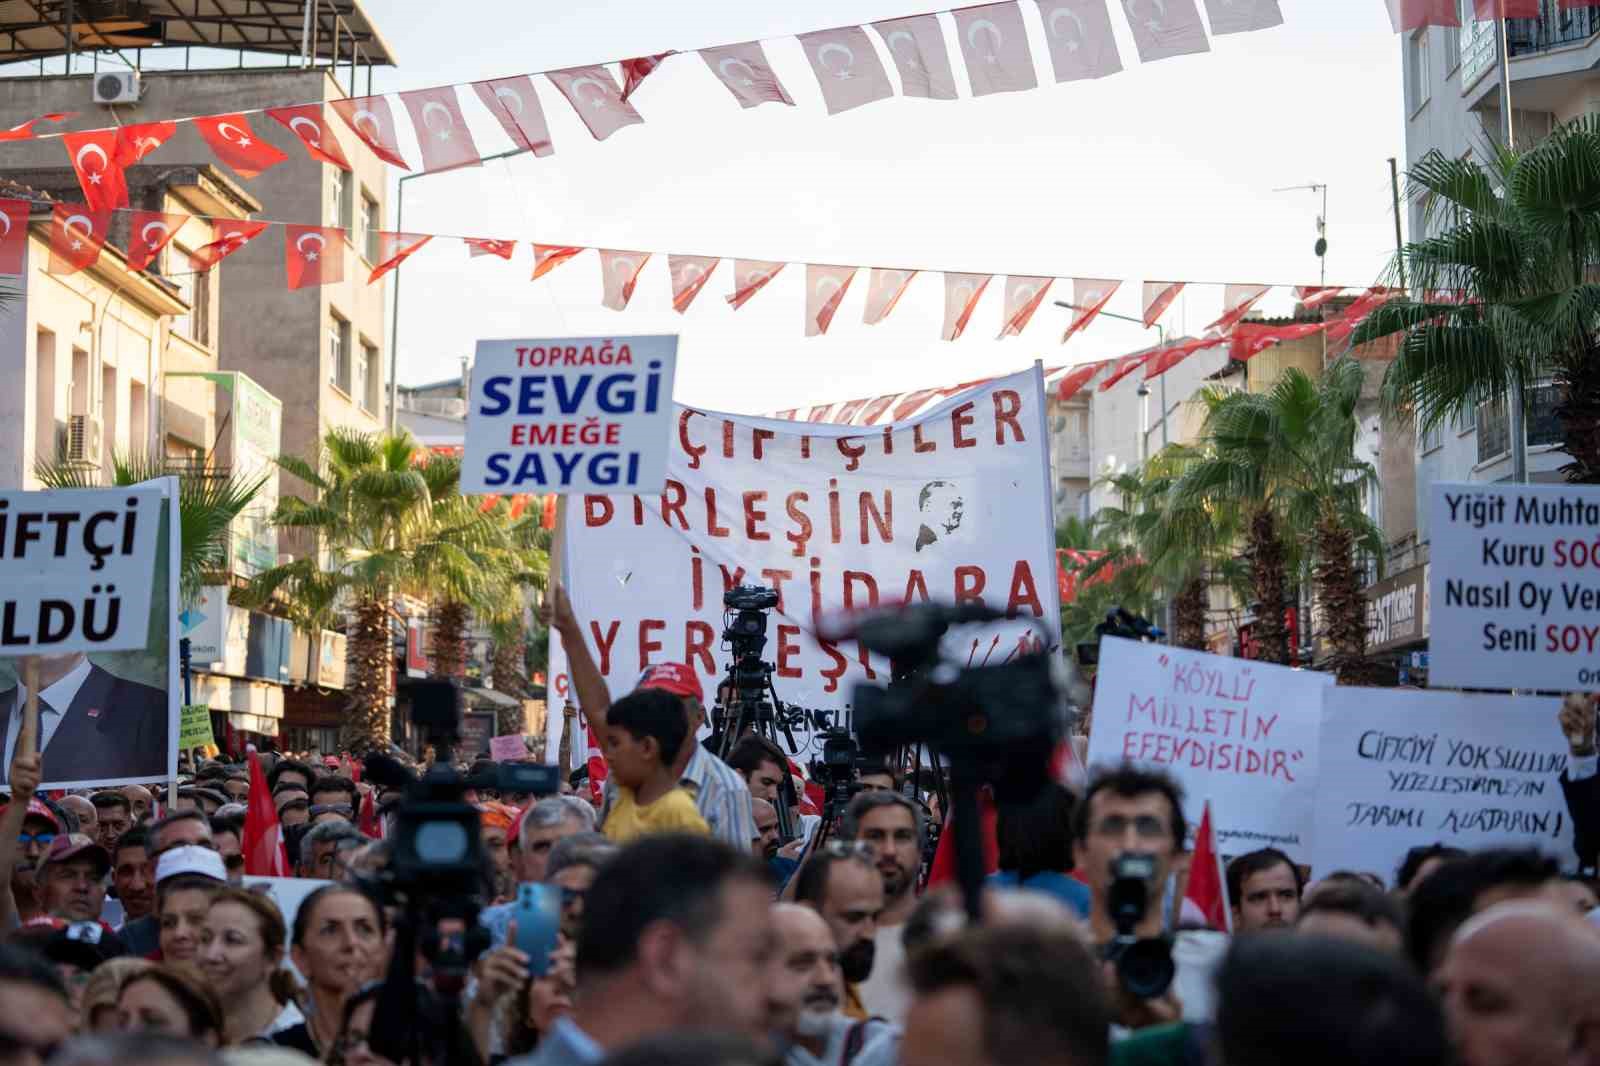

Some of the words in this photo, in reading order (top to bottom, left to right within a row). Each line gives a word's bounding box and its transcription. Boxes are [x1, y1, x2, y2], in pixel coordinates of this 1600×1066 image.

[515, 340, 633, 368] TOPRAĞA
[479, 360, 662, 416] SEVGİ
[510, 417, 623, 446] EMEĞE
[484, 451, 640, 486] SAYGI
[1445, 492, 1506, 529] Yiğit
[1482, 538, 1544, 568] Kuru
[1445, 579, 1511, 608] Nasıl
[1519, 581, 1553, 615] Oy
[1483, 623, 1536, 651] Seni
